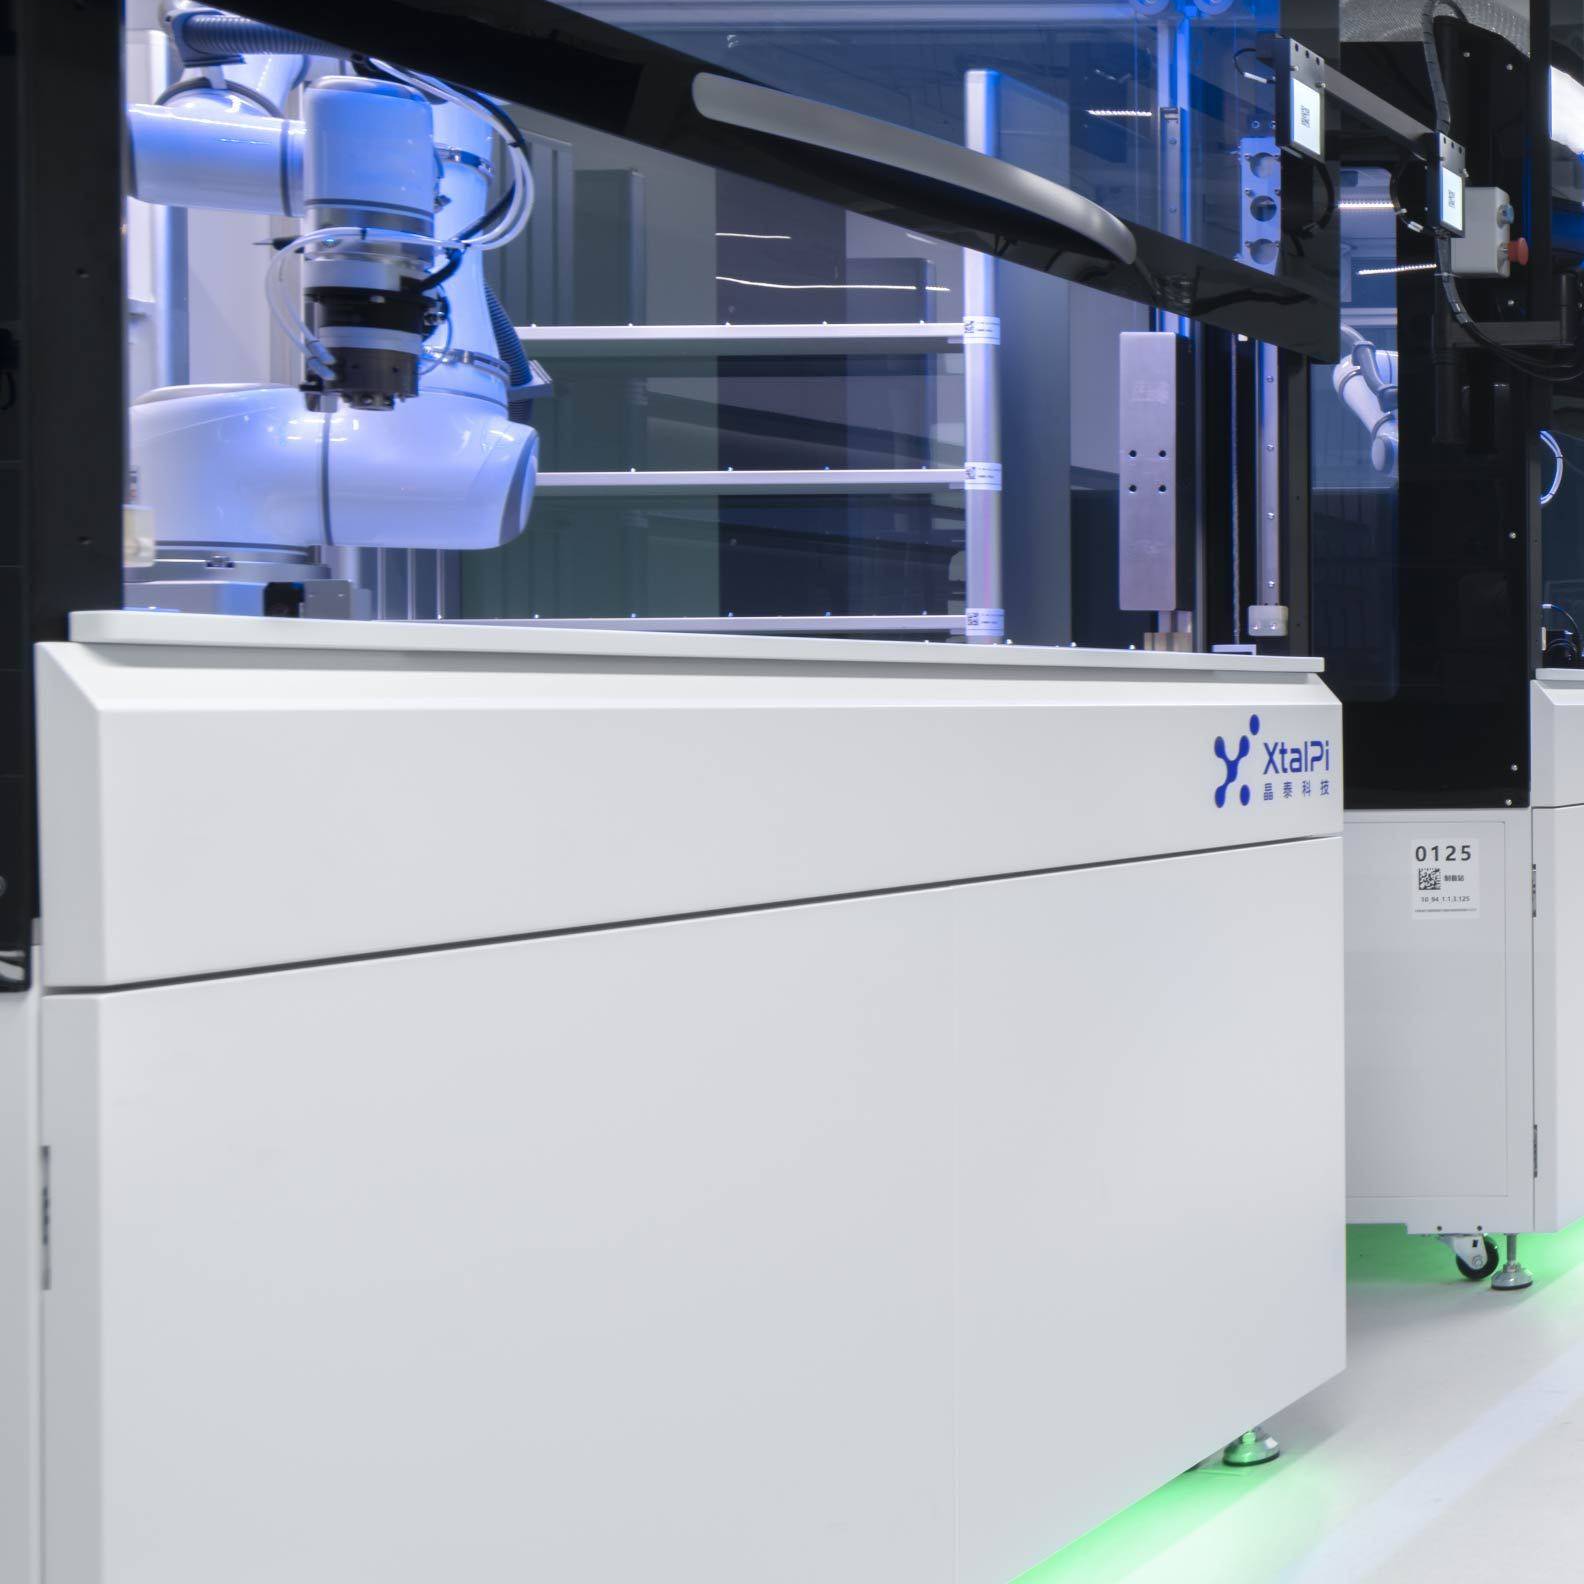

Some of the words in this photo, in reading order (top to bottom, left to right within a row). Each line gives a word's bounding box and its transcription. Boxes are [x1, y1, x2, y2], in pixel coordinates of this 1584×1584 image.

[1263, 740, 1330, 775] XtalPi
[1263, 780, 1330, 802] 晶泰科技
[1415, 845, 1472, 862] 0125
